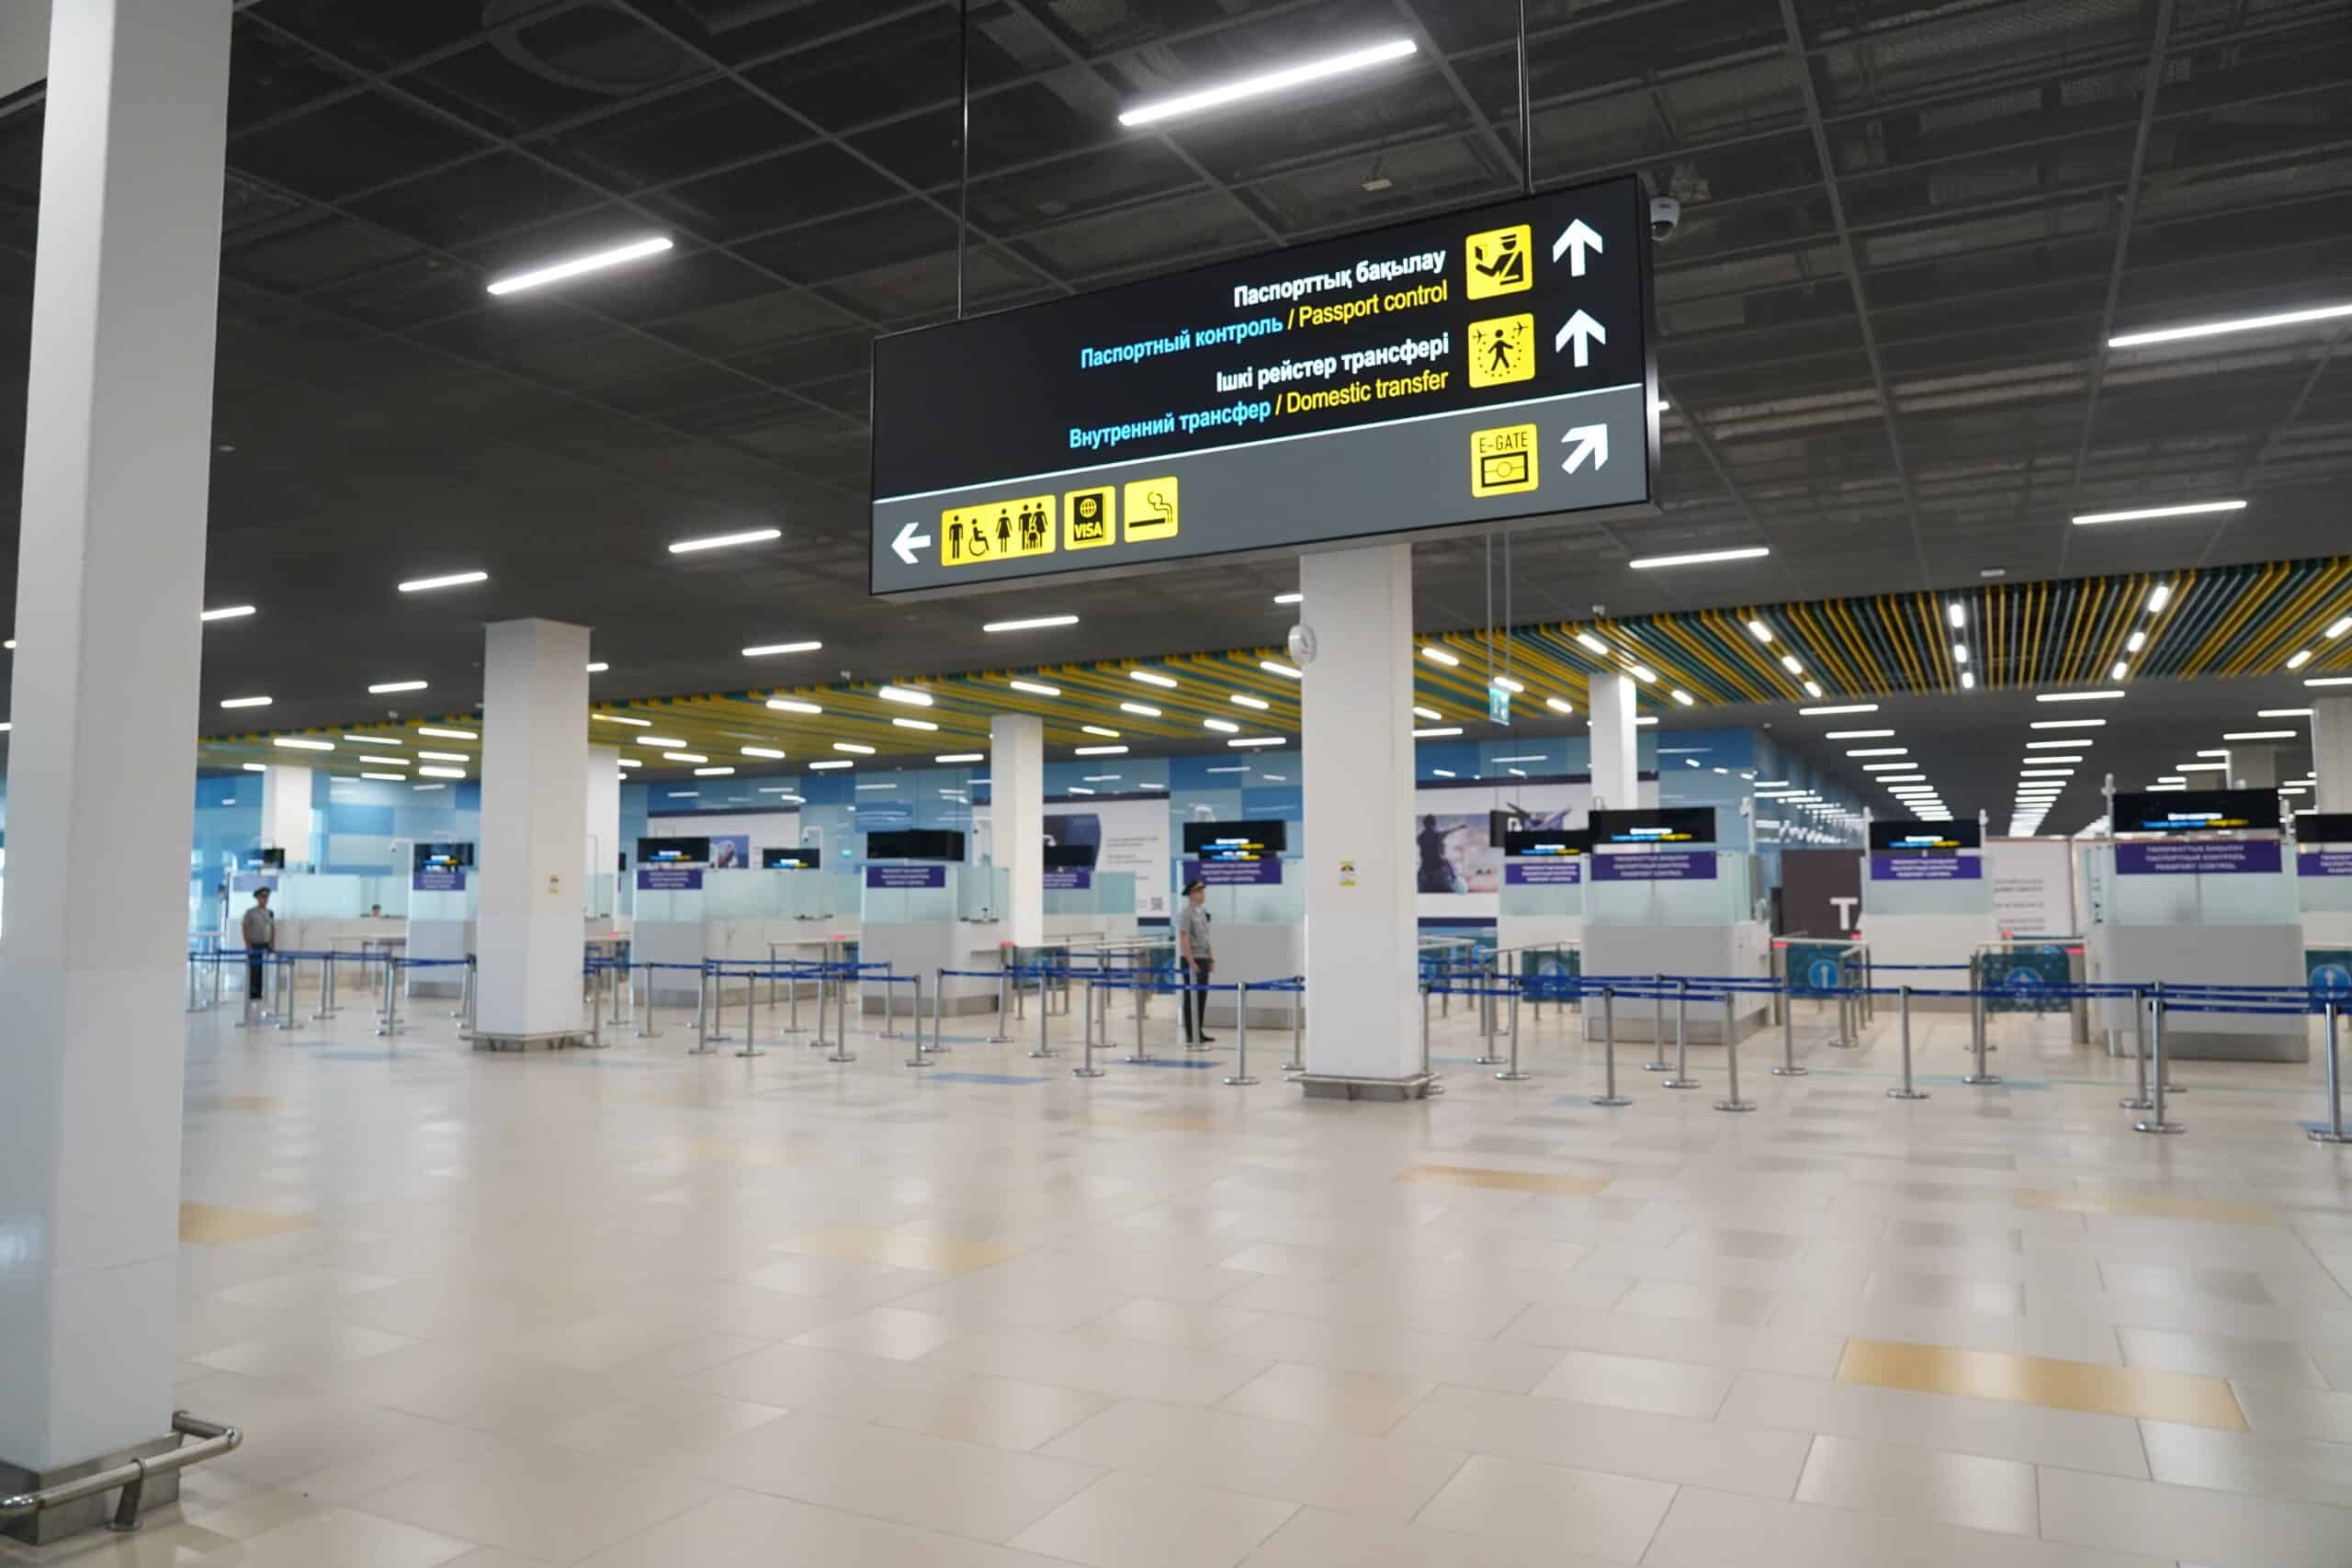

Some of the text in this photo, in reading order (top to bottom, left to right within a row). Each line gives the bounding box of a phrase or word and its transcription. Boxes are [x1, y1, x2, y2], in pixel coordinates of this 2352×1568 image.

[1234, 250, 1446, 308] Паспорттық бақылау
[1080, 279, 1448, 368] Паспортный контроль / Passport control
[1216, 332, 1449, 392] Ішкі рейстер трансфері
[1069, 369, 1449, 450] Внутренний трансфер / Domestic transfer
[1479, 431, 1529, 454] E-GATE
[1074, 521, 1102, 539] VISA
